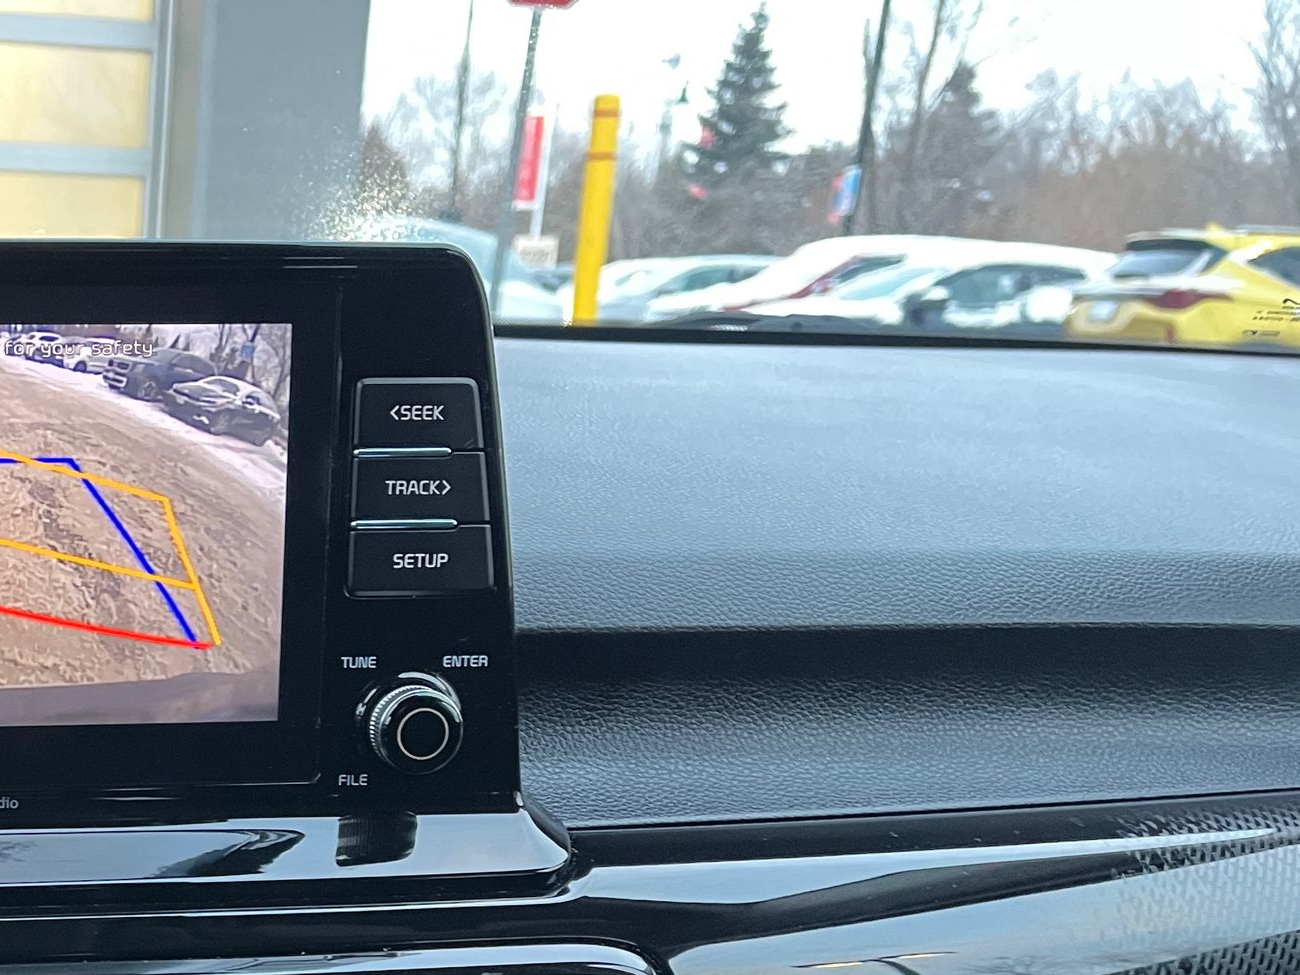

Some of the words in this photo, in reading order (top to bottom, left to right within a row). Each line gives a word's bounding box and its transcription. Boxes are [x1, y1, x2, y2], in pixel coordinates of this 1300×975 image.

[5, 340, 34, 355] for
[41, 345, 84, 358] your
[393, 554, 448, 568] SETUP
[341, 657, 376, 668] TUNE
[443, 655, 488, 667] ENTER
[339, 774, 367, 785] FILE
